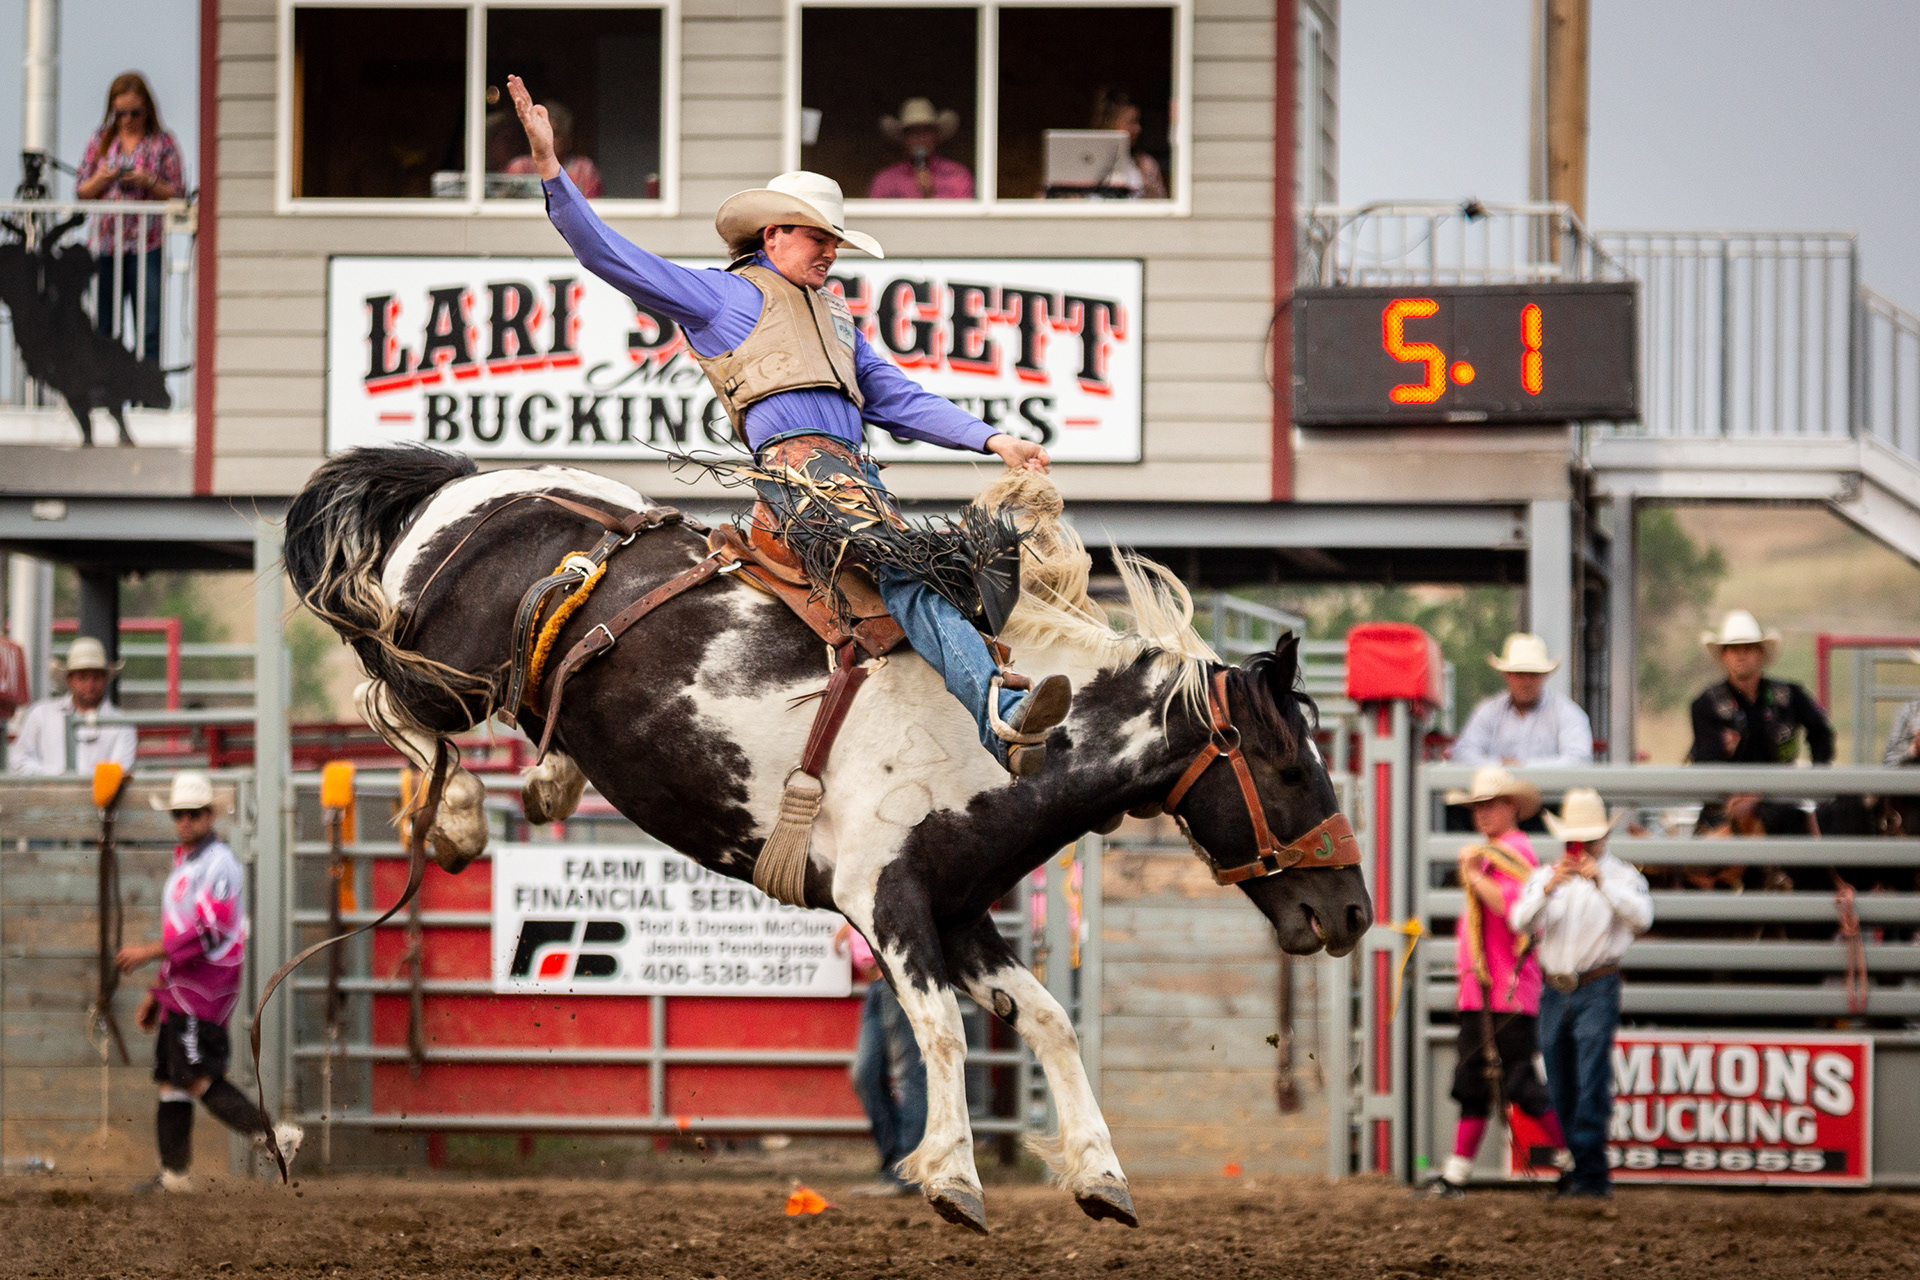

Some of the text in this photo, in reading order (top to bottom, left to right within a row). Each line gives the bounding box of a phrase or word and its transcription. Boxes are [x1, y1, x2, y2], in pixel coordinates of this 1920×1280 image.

[364, 276, 583, 396] LARI
[562, 856, 646, 883] FARM
[515, 887, 826, 913] FINANCIAL SERV
[638, 919, 835, 937] Rod & Doreen McClure
[719, 940, 829, 961] Pendergrass
[641, 964, 819, 987] 406-538-3817
[1609, 1043, 1855, 1117] MMONS
[1607, 1097, 1819, 1146] RUCKING
